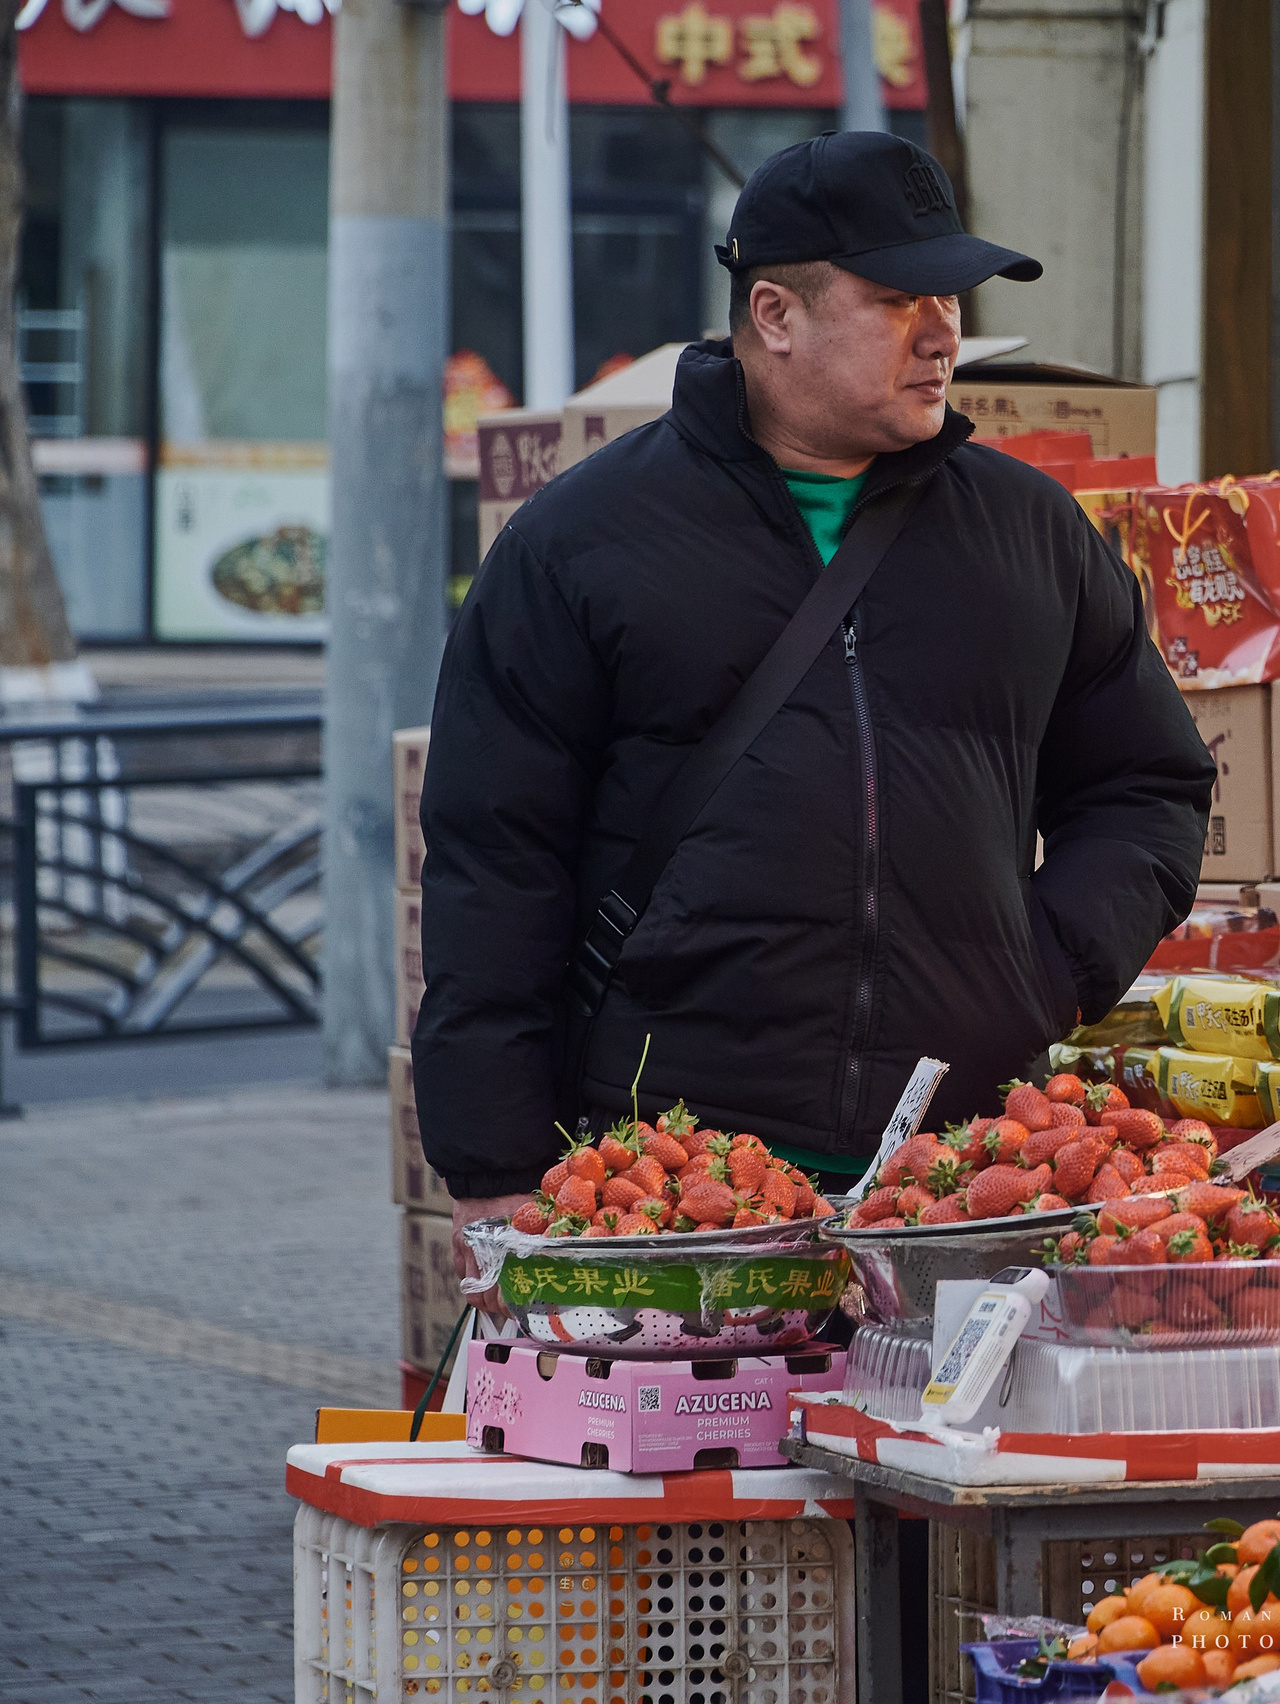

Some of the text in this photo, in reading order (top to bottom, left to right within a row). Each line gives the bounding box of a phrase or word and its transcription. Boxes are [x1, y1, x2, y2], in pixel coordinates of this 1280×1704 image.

[1224, 1007, 1262, 1028] 花生汤
[508, 1265, 655, 1297] 潘氏果业
[754, 1377, 768, 1386] CAT
[578, 1390, 627, 1413] AZUCENA
[675, 1391, 772, 1414] AZUCENA
[588, 1416, 615, 1429] PREMIUM
[697, 1415, 750, 1428] PREMIUM
[587, 1427, 615, 1440] CHERRIES
[696, 1428, 751, 1441] CHERRIES
